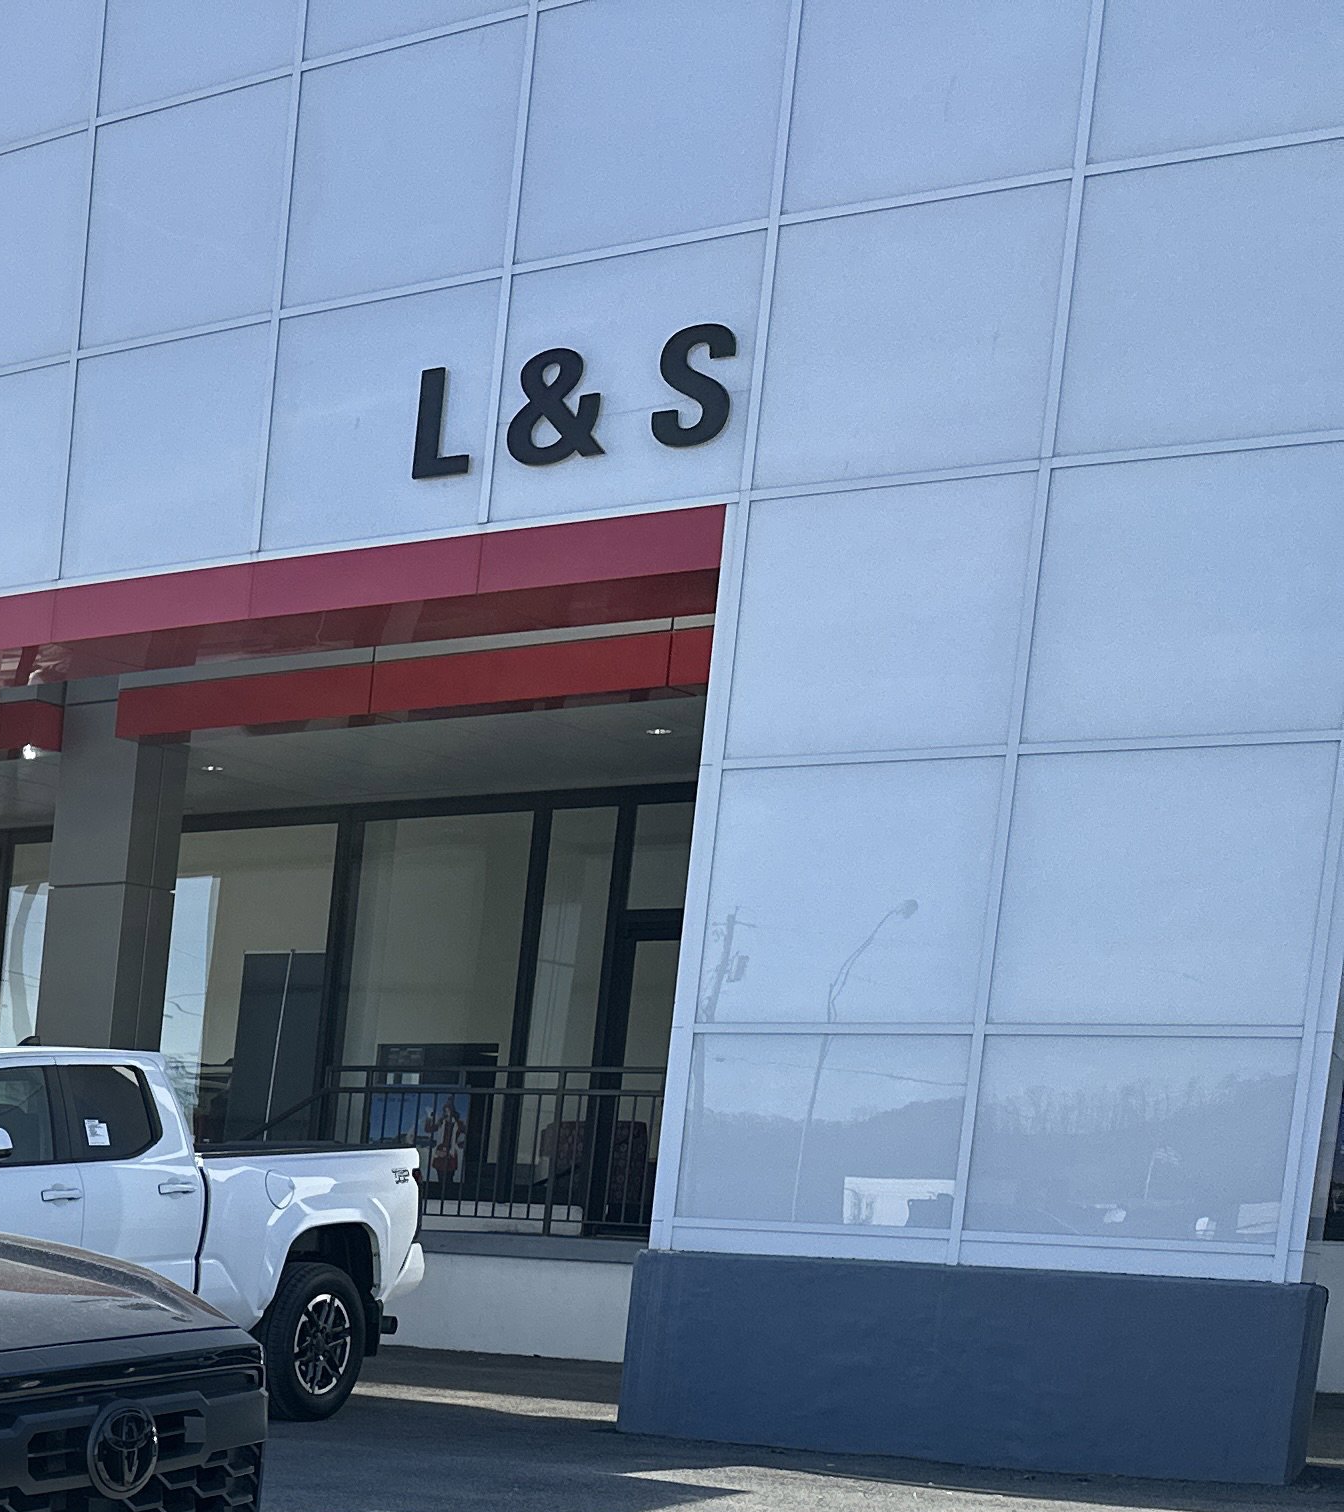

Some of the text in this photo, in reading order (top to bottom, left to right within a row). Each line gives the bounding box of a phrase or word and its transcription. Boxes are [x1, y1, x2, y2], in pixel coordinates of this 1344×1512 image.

[412, 323, 737, 479] L & S
